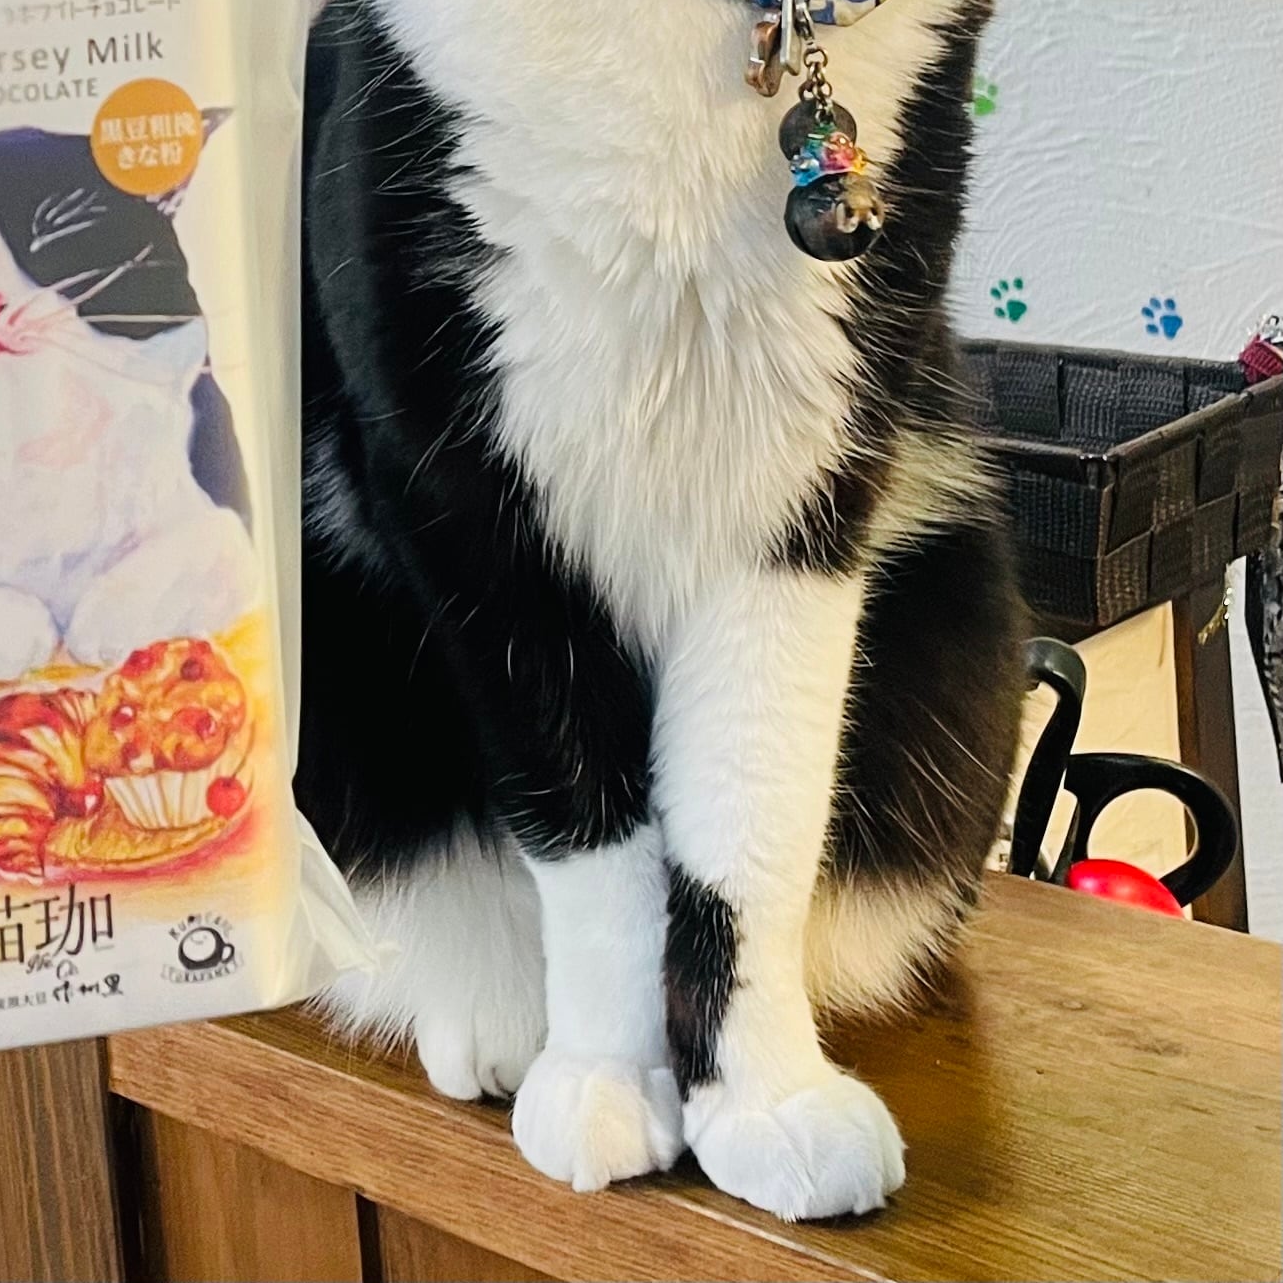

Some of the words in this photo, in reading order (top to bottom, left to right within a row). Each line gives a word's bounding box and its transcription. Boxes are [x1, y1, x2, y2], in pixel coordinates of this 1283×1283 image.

[87, 32, 164, 66] Milk
[118, 141, 182, 170] きな粉
